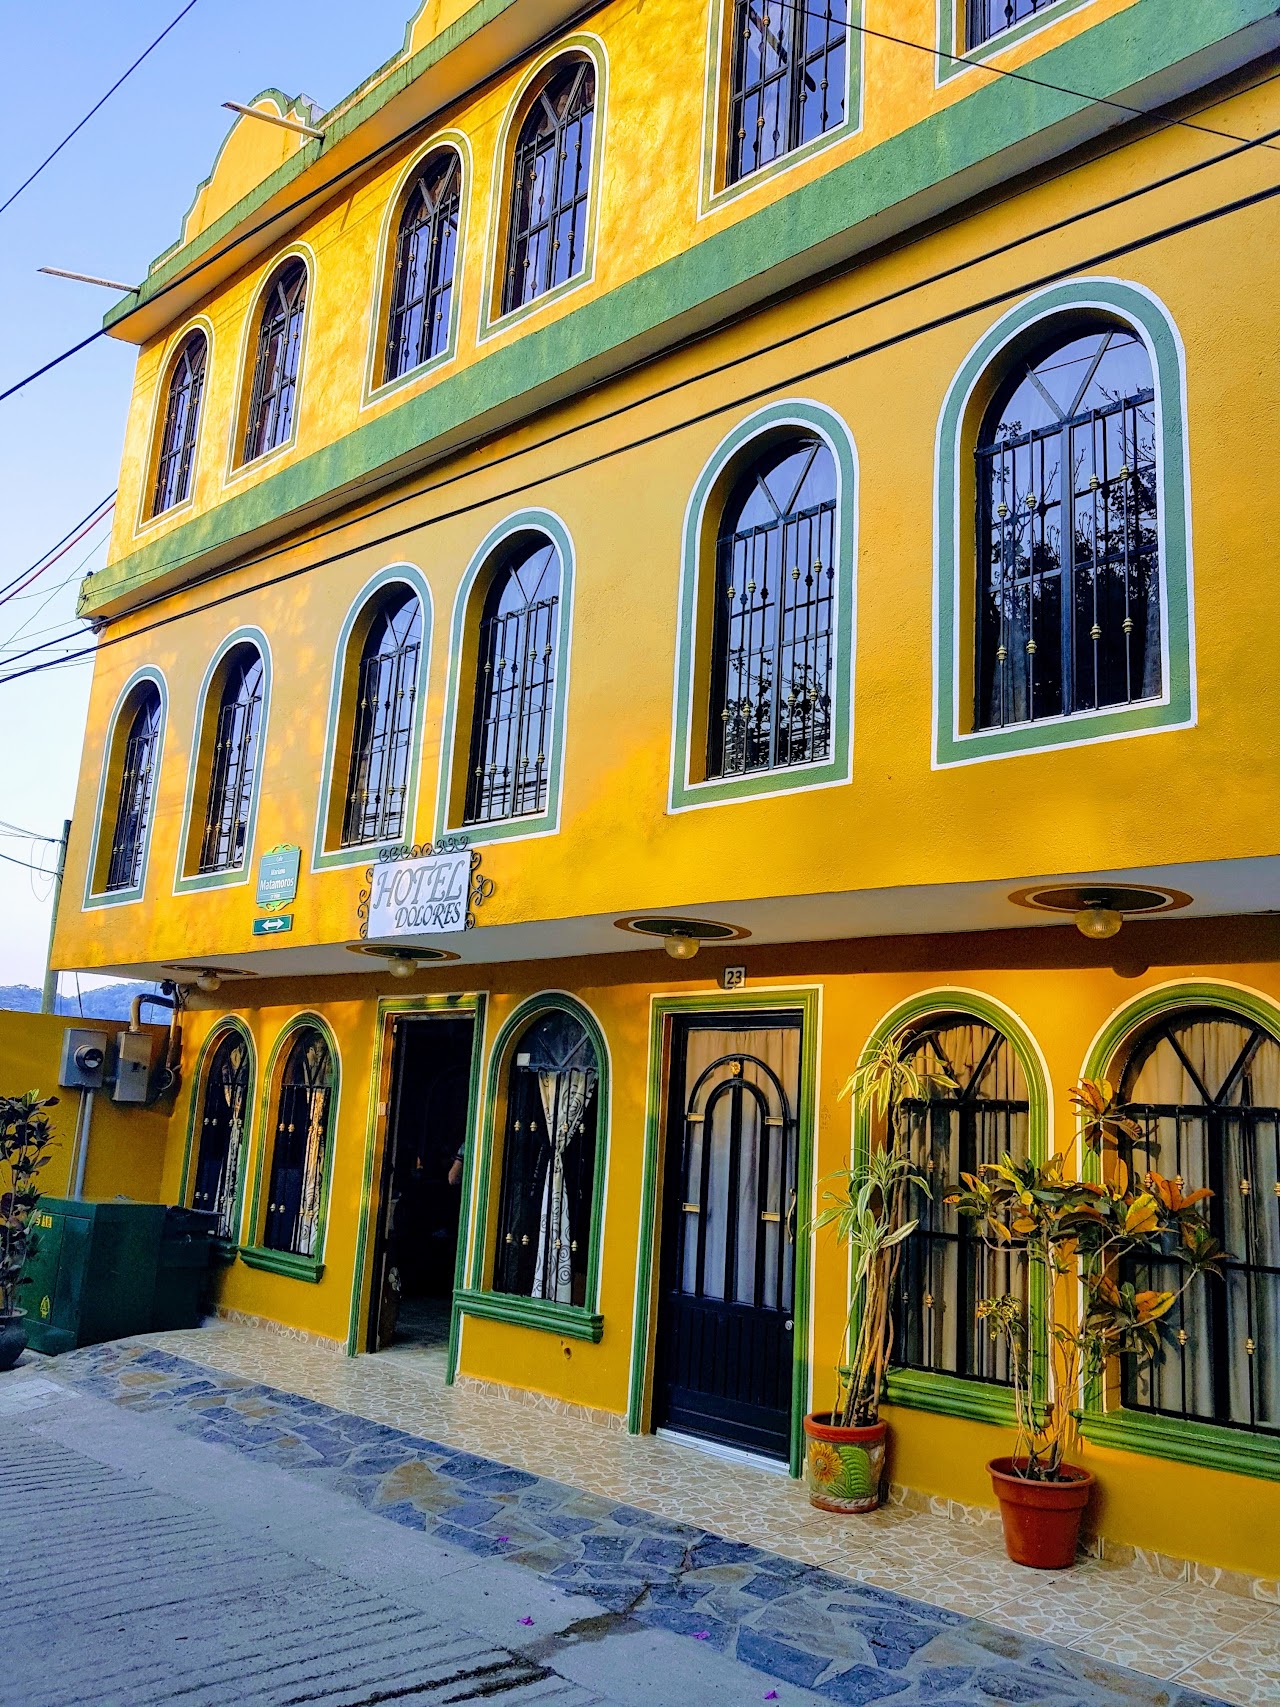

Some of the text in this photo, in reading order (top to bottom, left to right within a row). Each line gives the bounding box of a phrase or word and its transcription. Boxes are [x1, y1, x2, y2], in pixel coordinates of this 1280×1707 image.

[259, 877, 295, 891] Matamoros
[373, 860, 465, 909] HOTEL
[395, 902, 461, 928] DOLORES
[727, 970, 742, 984] 23
